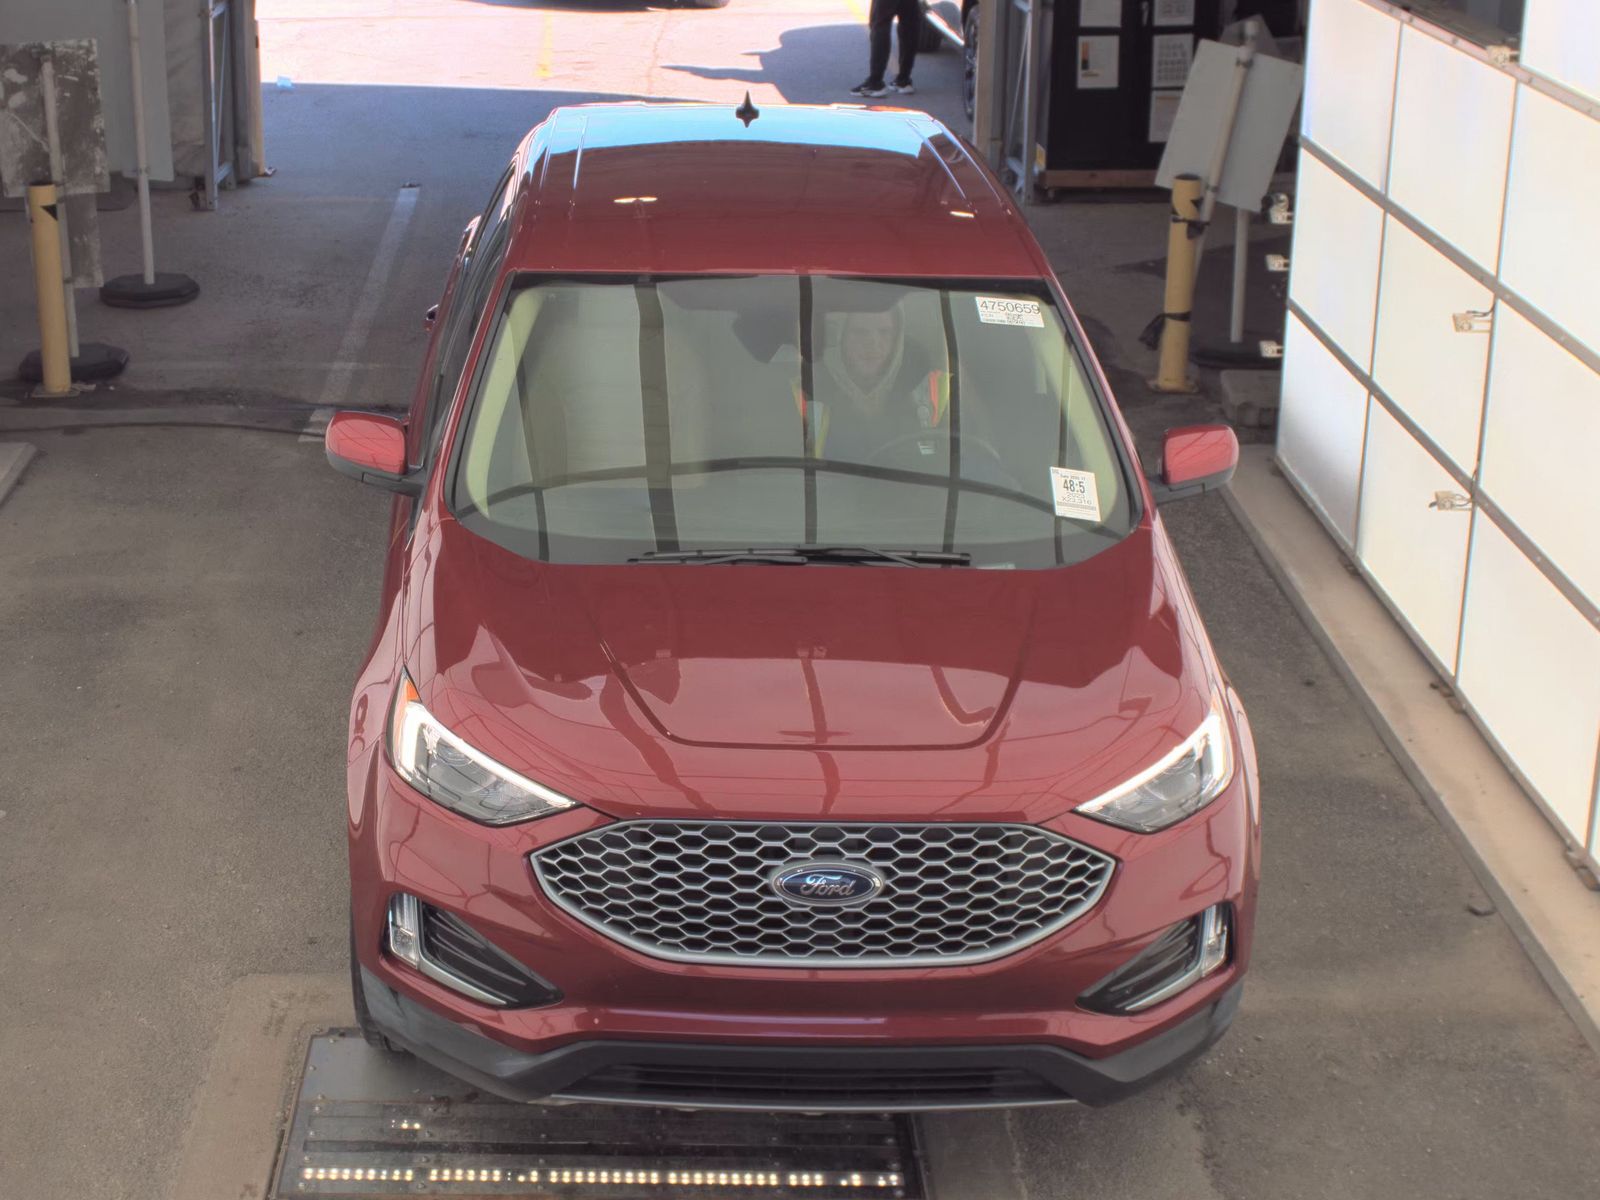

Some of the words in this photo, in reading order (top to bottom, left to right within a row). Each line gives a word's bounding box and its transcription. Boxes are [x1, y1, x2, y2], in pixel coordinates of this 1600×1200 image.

[980, 300, 1041, 315] 4750659
[1063, 479, 1086, 494] 48:5
[800, 873, 856, 896] Ford
